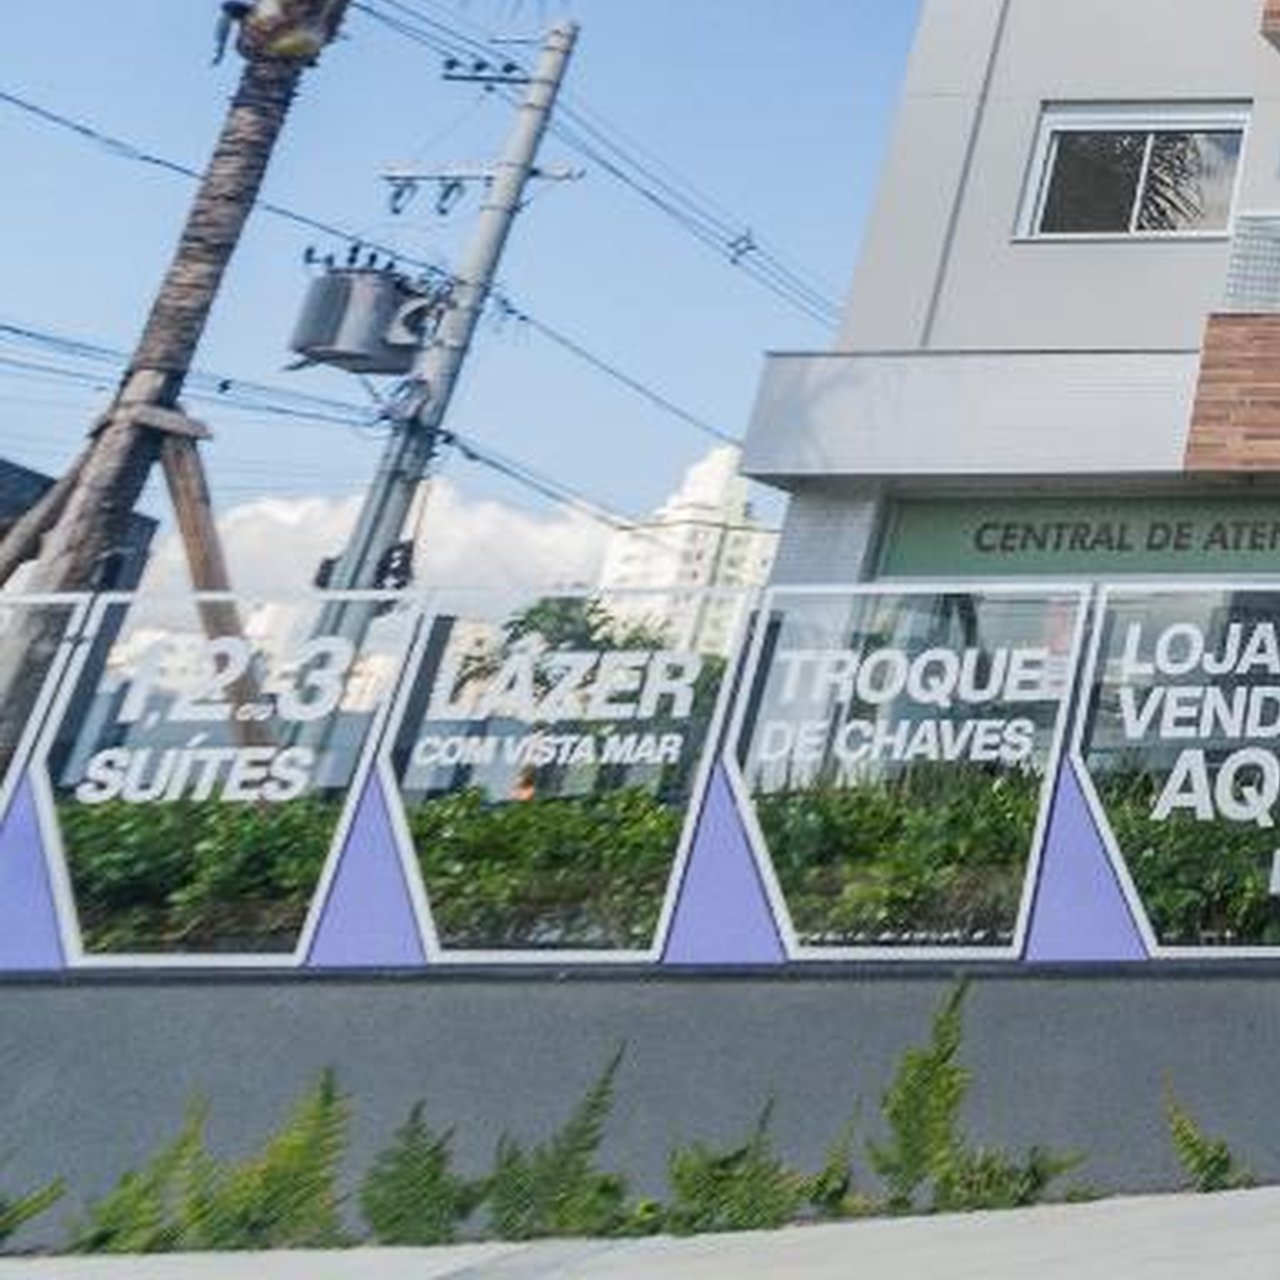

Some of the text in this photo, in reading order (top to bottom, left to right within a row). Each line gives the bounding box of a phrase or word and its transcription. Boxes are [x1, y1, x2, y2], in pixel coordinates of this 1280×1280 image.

[974, 520, 1133, 553] CENTRAL
[1145, 520, 1196, 552] DE
[775, 647, 1049, 706] TROQUE
[414, 733, 497, 764] COM
[602, 732, 683, 763] MAR
[759, 718, 1033, 761] DE CHAVES
[76, 730, 314, 803] SUÍTES
